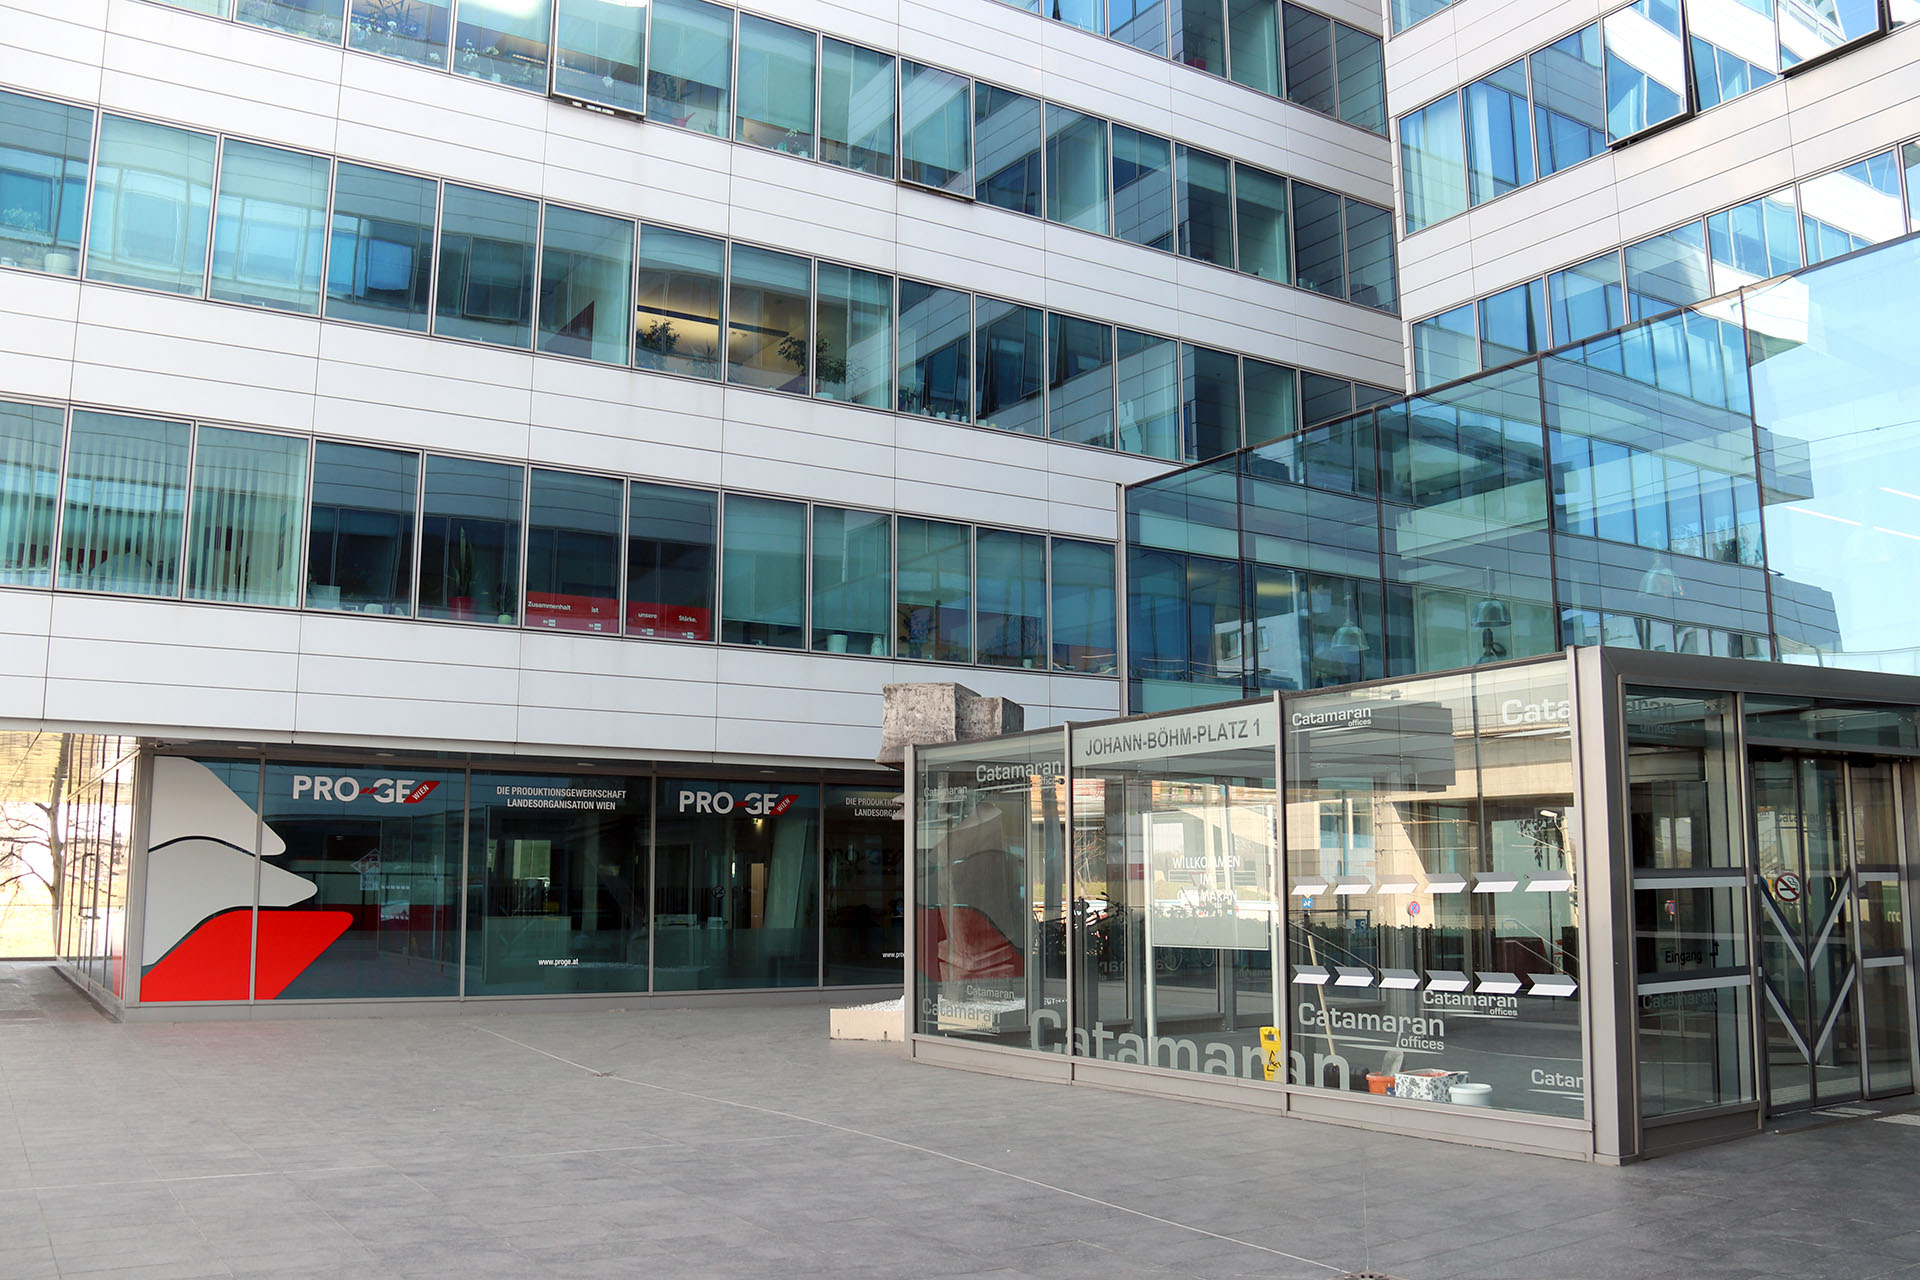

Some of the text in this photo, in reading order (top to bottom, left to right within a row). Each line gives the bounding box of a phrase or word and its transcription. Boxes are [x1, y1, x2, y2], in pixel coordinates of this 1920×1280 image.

[527, 601, 571, 611] Zusammenhalt
[1292, 707, 1372, 726] Catamaran
[1347, 719, 1372, 727] offices
[1085, 718, 1261, 757] JOHANN-BÖHM-PLATZ 1
[976, 760, 1062, 782] Catamaran
[412, 784, 430, 801] WIEN
[496, 786, 626, 798] DIE PRODUKTIONSGEWERKSCHAFT
[507, 798, 616, 810] LANDESORGANISATION WIEN
[776, 798, 791, 813] WIEN
[845, 797, 857, 806] DIE
[854, 808, 900, 817] LANDESORGA
[538, 958, 579, 967] www.proge.at
[1665, 950, 1703, 966] Eingang
[966, 984, 1015, 999] Catamaran
[1423, 990, 1518, 1008] Catamaran
[922, 998, 1000, 1024] Catamaran
[1489, 1007, 1518, 1016] offices
[1298, 1002, 1445, 1037] Catamaran
[1400, 1036, 1445, 1050] offices
